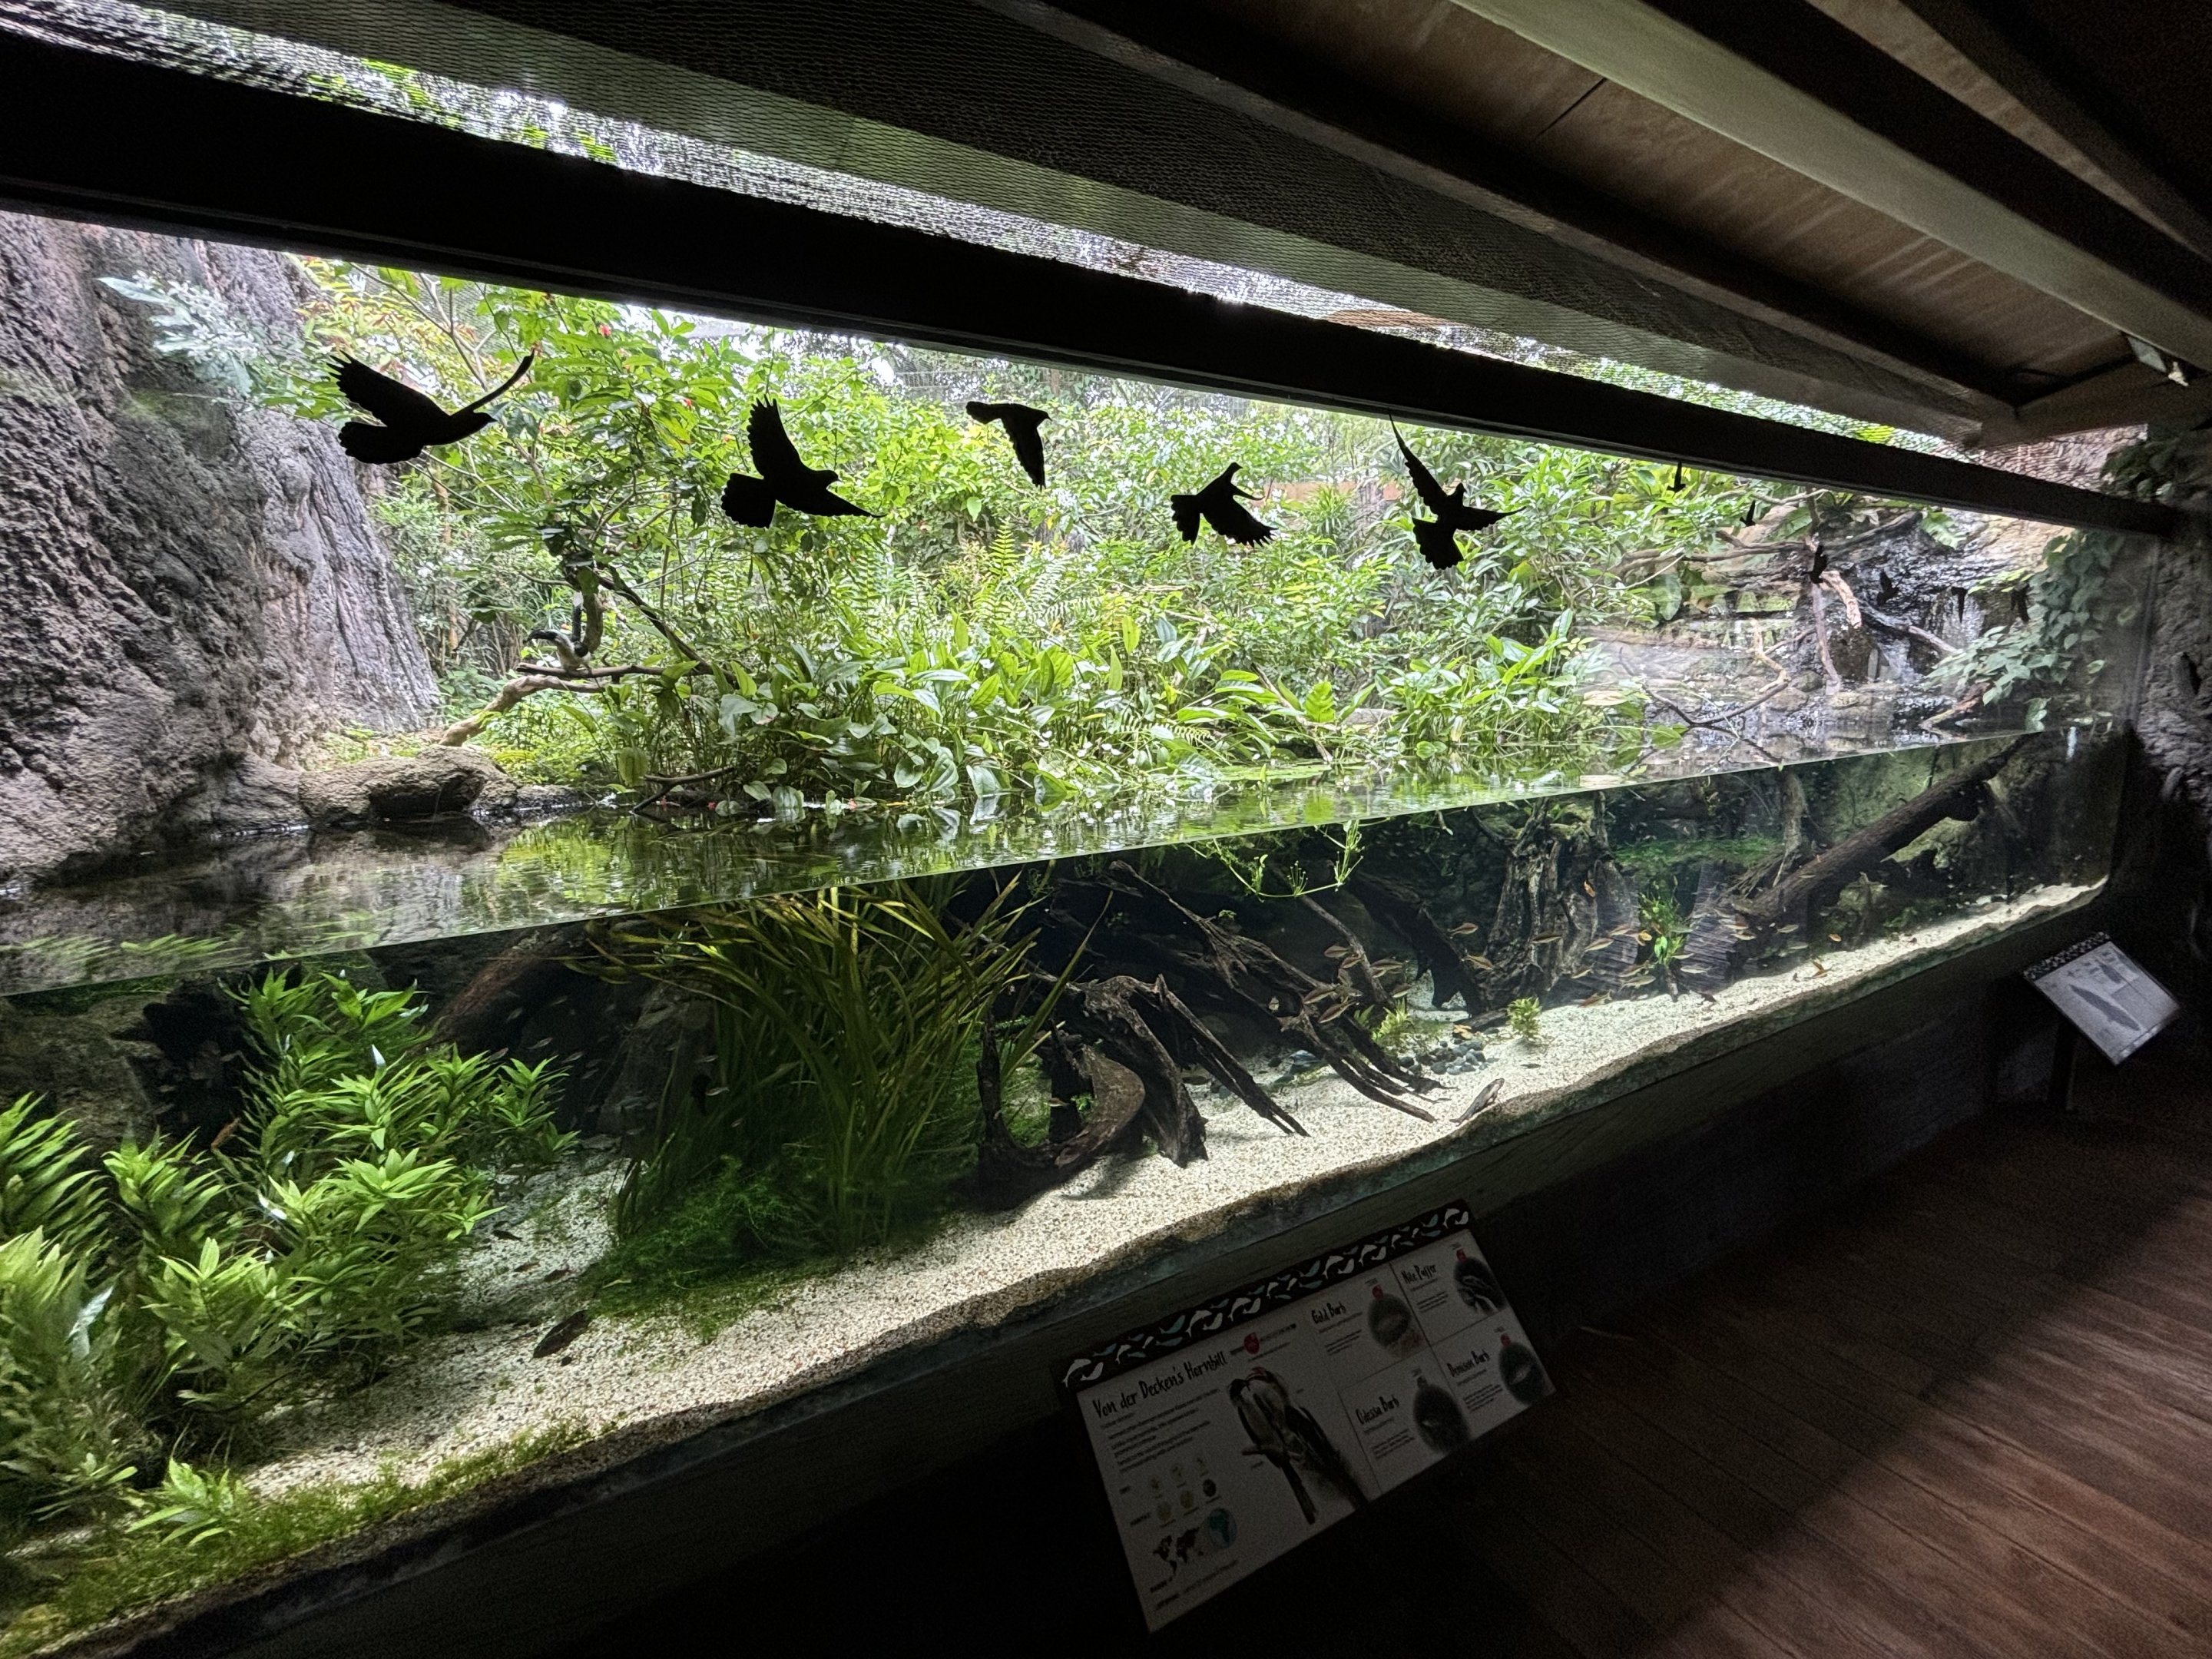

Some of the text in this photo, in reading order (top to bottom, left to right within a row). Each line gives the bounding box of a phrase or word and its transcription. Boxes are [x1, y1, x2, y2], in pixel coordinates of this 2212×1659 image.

[1311, 1305, 1330, 1325] Gold
[1328, 1302, 1346, 1319] Barb
[1471, 1349, 1490, 1366] Barb
[1092, 1399, 1117, 1419] Von
[1121, 1392, 1137, 1409] der
[1137, 1366, 1184, 1399] Decken's
[1184, 1351, 1228, 1380] Hornbill
[1379, 1394, 1399, 1411] Barb
